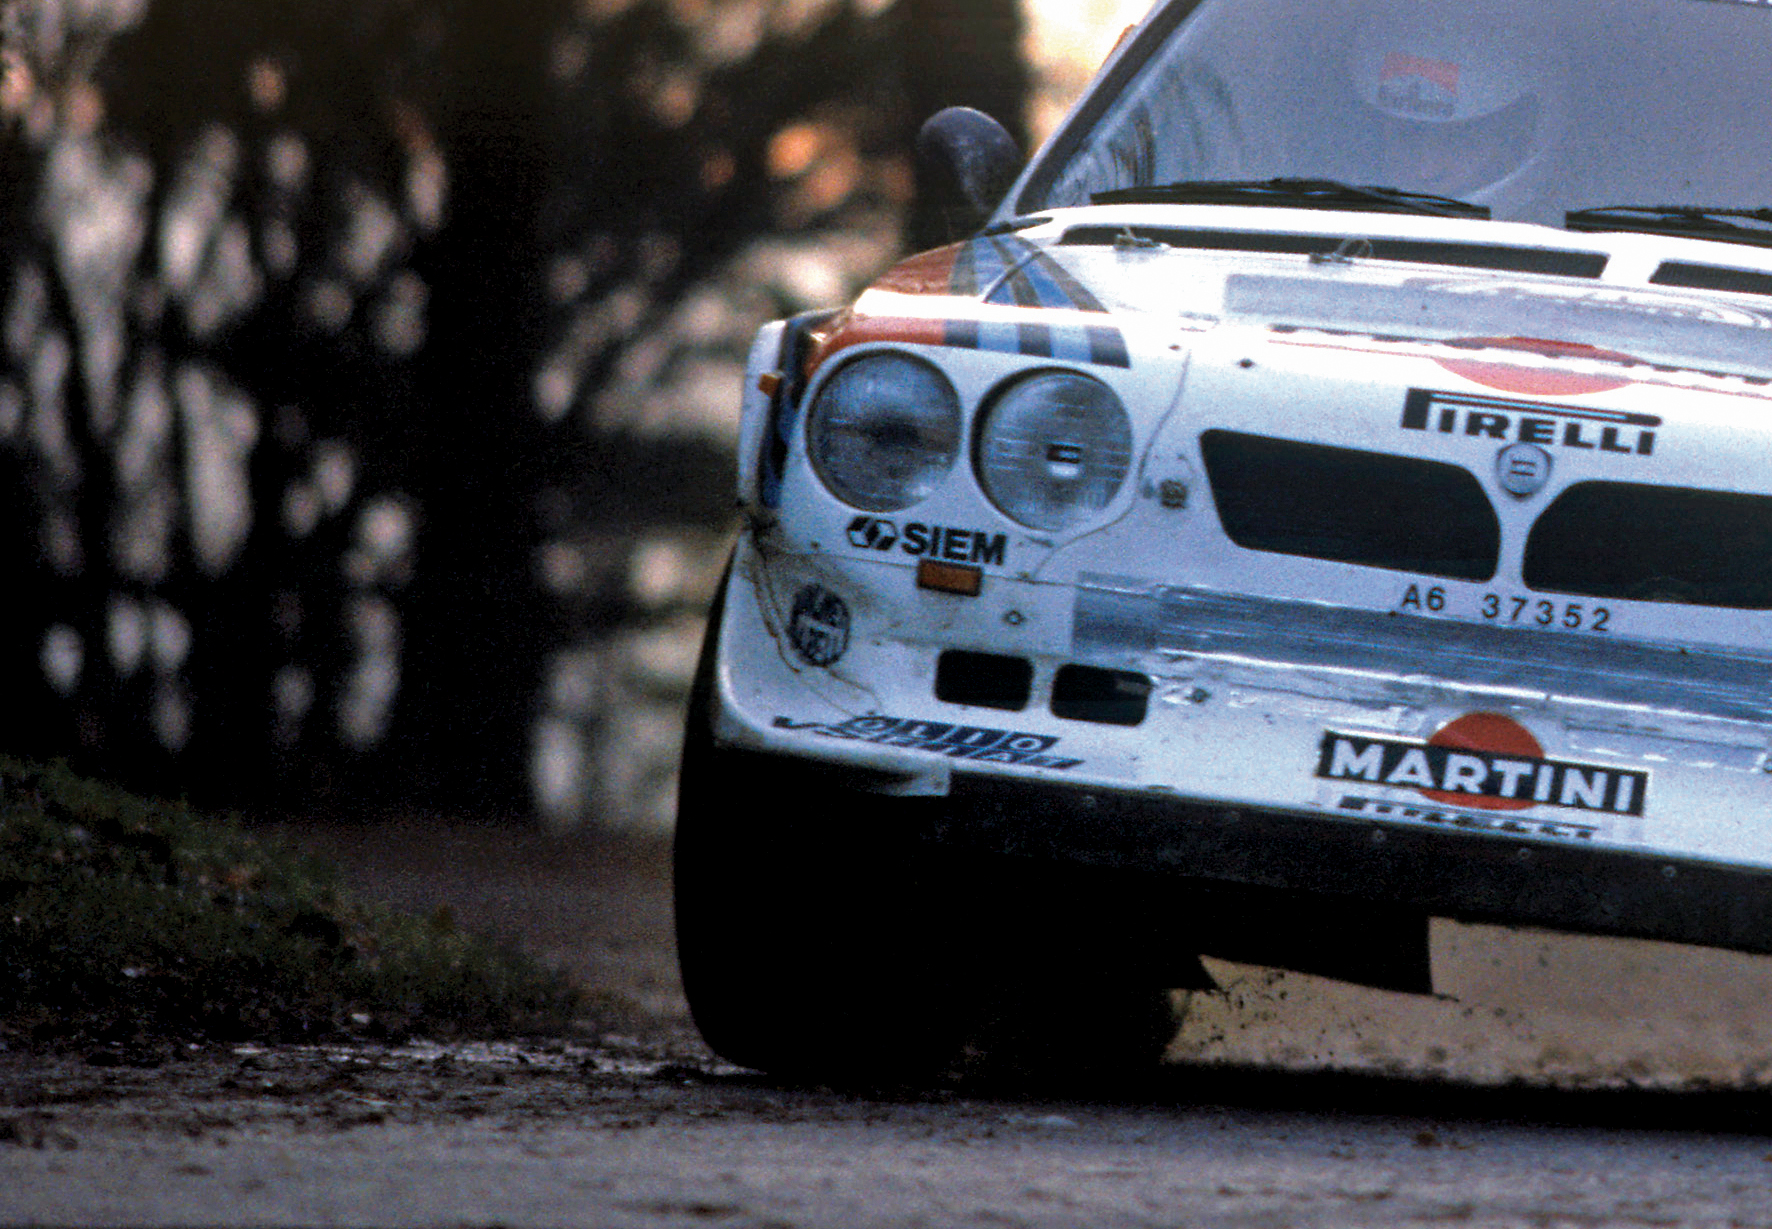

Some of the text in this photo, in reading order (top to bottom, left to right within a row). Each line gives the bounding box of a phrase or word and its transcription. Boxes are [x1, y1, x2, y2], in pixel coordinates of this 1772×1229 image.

[1401, 387, 1662, 456] PIRELLI
[901, 522, 1007, 566] SIEM
[1401, 583, 1610, 632] A6 37352
[1328, 738, 1637, 813] MARTINI
